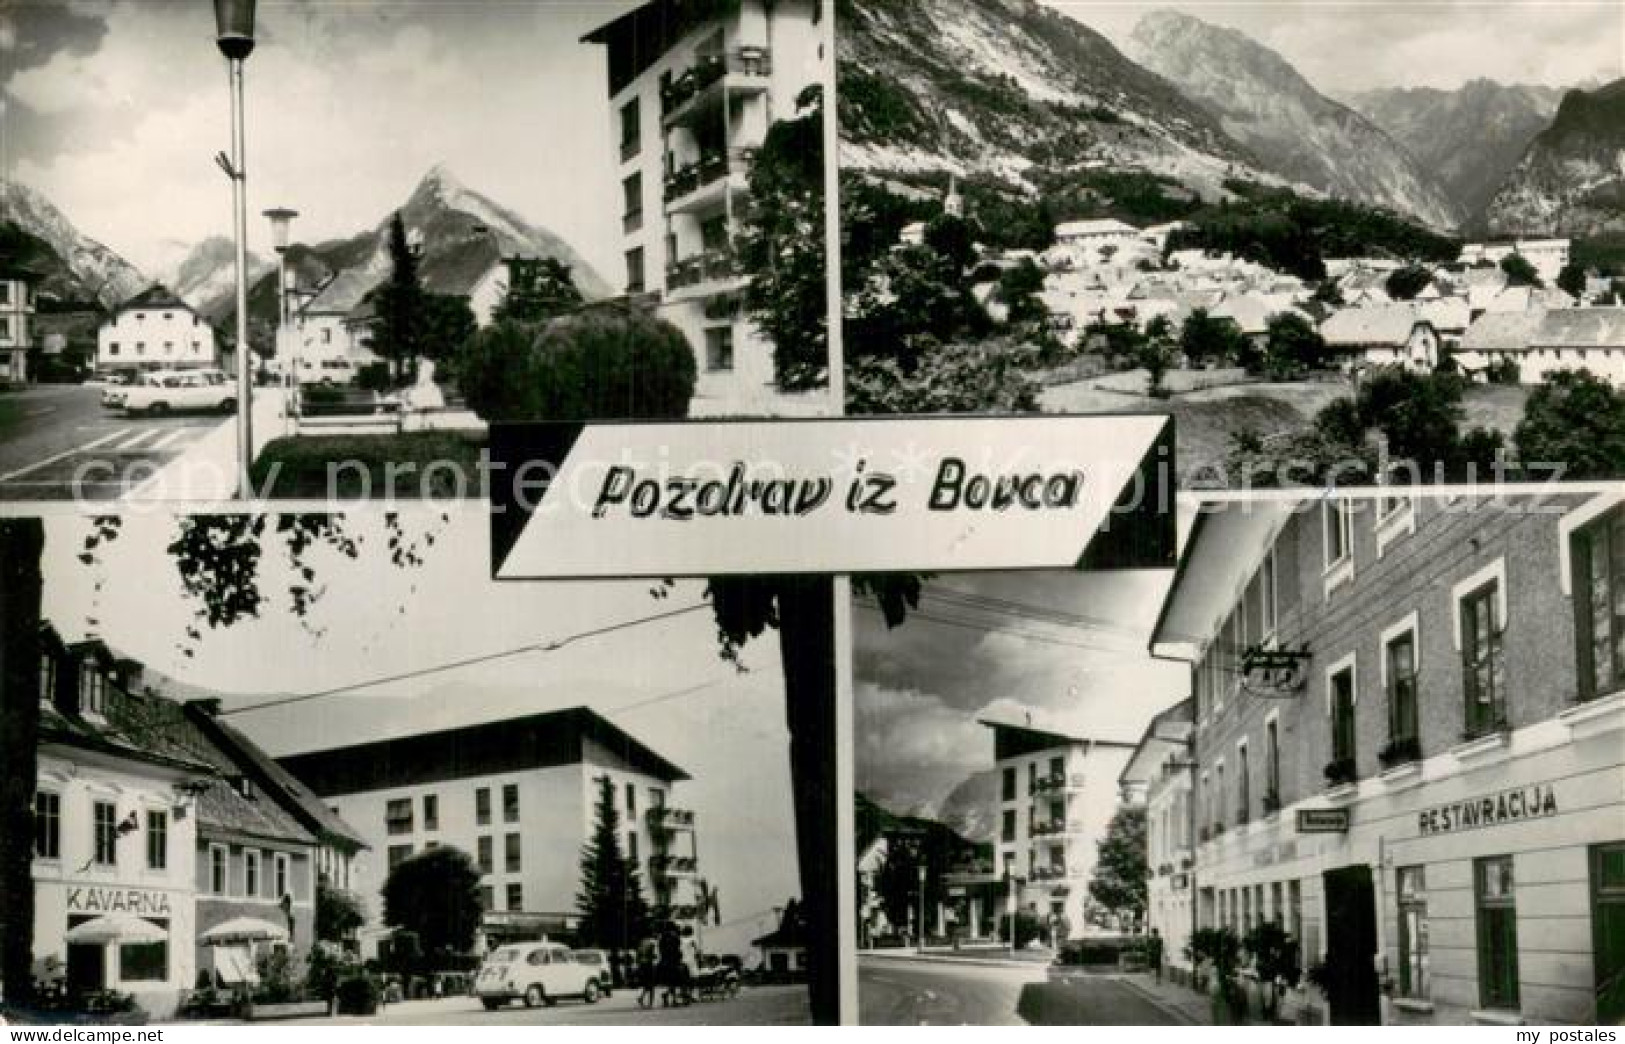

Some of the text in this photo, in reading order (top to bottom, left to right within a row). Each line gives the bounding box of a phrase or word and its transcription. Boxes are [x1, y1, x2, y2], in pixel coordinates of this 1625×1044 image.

[592, 456, 1085, 521] Pozdrav iz Bovca
[1418, 786, 1559, 836] RESTAVRACIJA
[66, 887, 171, 914] KAVARNA
